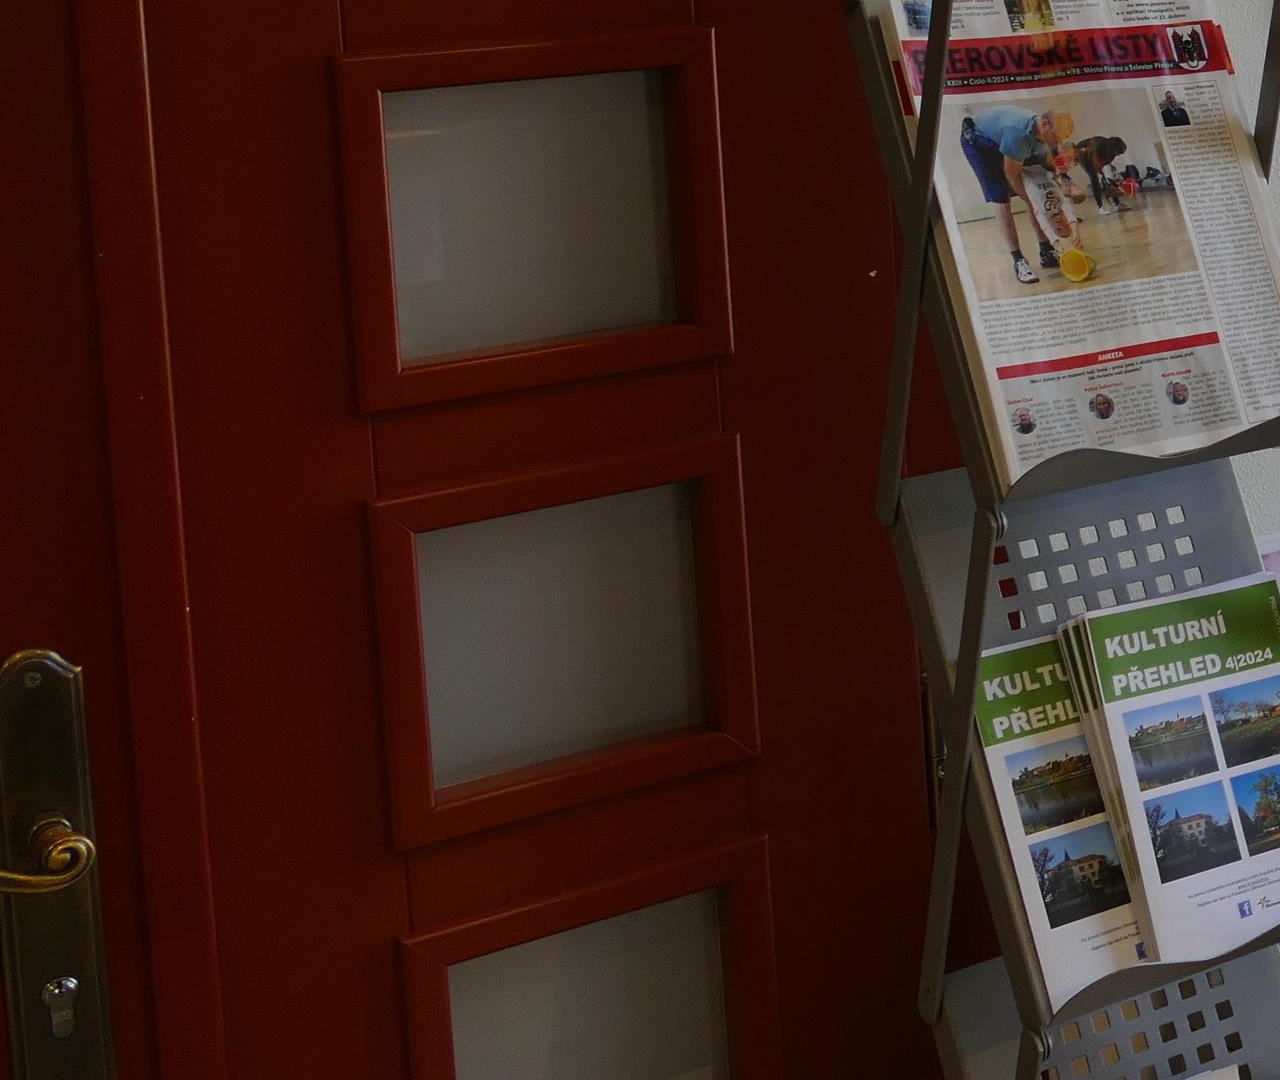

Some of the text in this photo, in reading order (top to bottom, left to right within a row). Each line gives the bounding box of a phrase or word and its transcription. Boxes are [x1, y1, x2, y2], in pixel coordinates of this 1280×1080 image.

[912, 32, 1159, 75] PEROVSKÉ LISTY
[1097, 351, 1124, 361] ANKETA
[1105, 610, 1227, 659] KULTURNÍ
[1112, 653, 1222, 697] PŘEHLED
